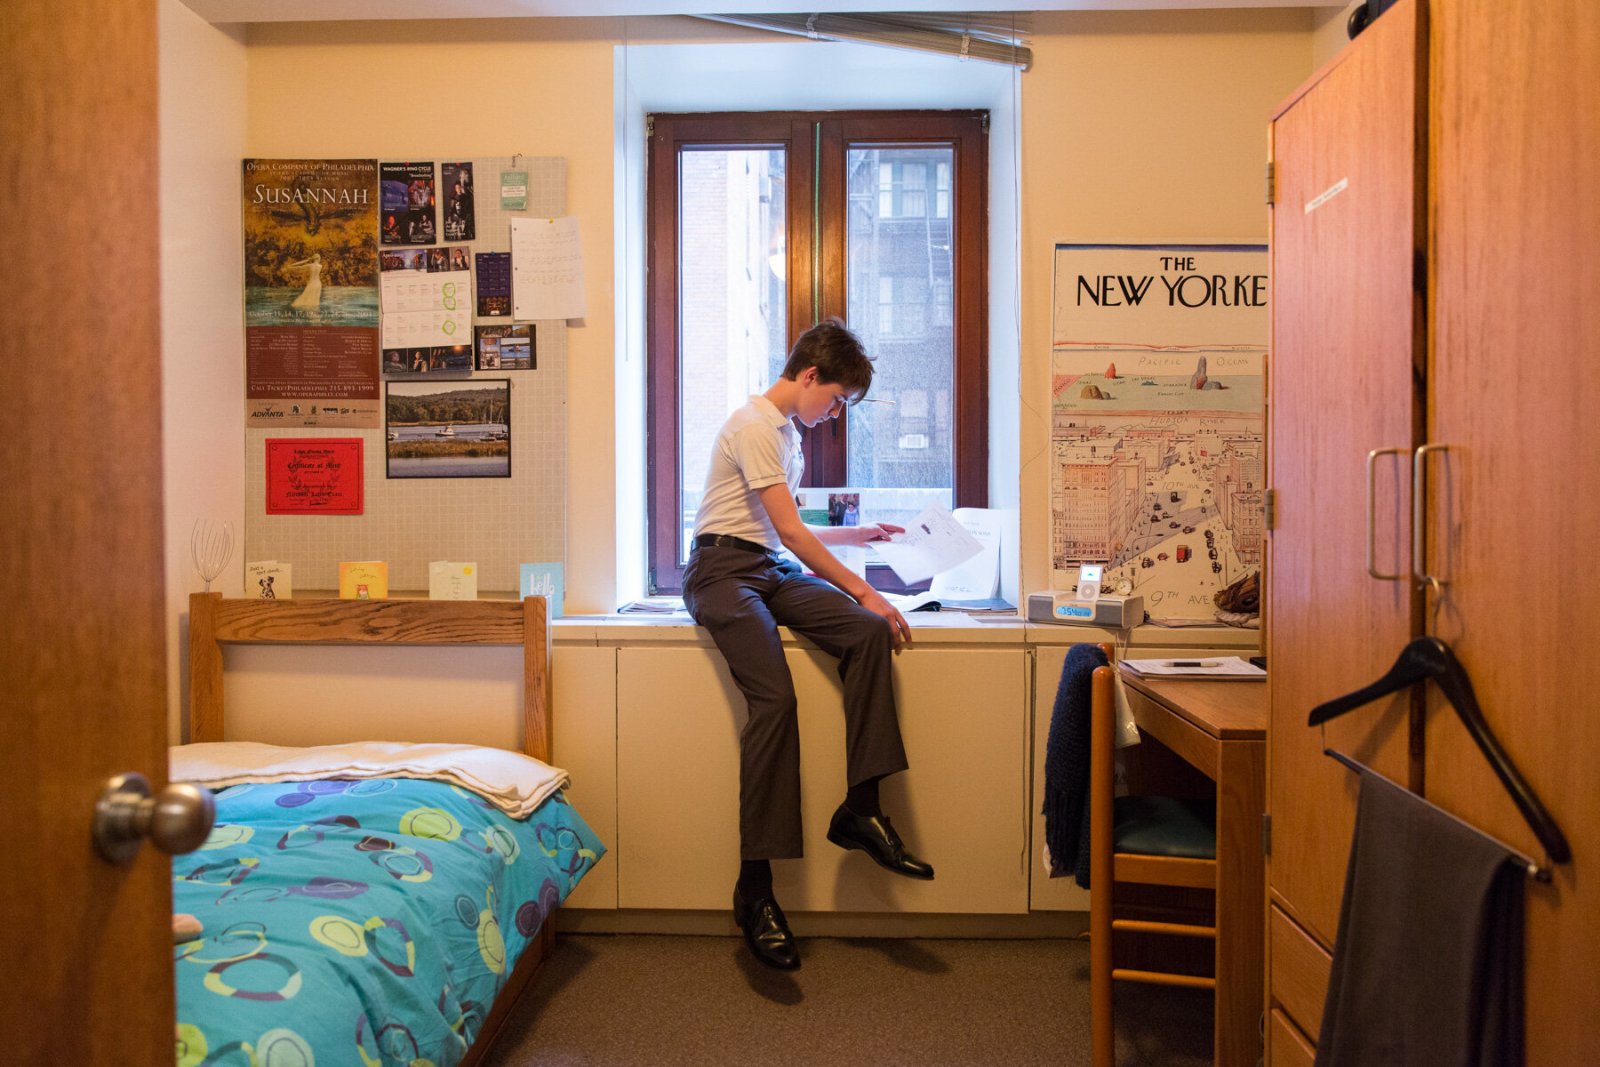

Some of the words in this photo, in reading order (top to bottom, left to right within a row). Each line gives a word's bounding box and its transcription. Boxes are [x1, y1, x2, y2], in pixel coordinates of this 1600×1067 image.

[247, 162, 270, 171] OPERA
[272, 162, 309, 171] COMPANY
[310, 163, 320, 171] OF
[321, 162, 375, 172] PHILADELPHIA
[253, 184, 368, 204] SUSANNAH
[1160, 257, 1196, 271] THE
[1077, 275, 1154, 307] NEW
[1161, 275, 1268, 308] YORKE
[1138, 357, 1182, 366] PACIFIC
[1216, 356, 1249, 366] OCEAN
[1149, 416, 1189, 426] HUDSON
[1199, 418, 1225, 426] RIVER
[1150, 590, 1179, 607] 9TH
[1188, 595, 1209, 606] AVE
